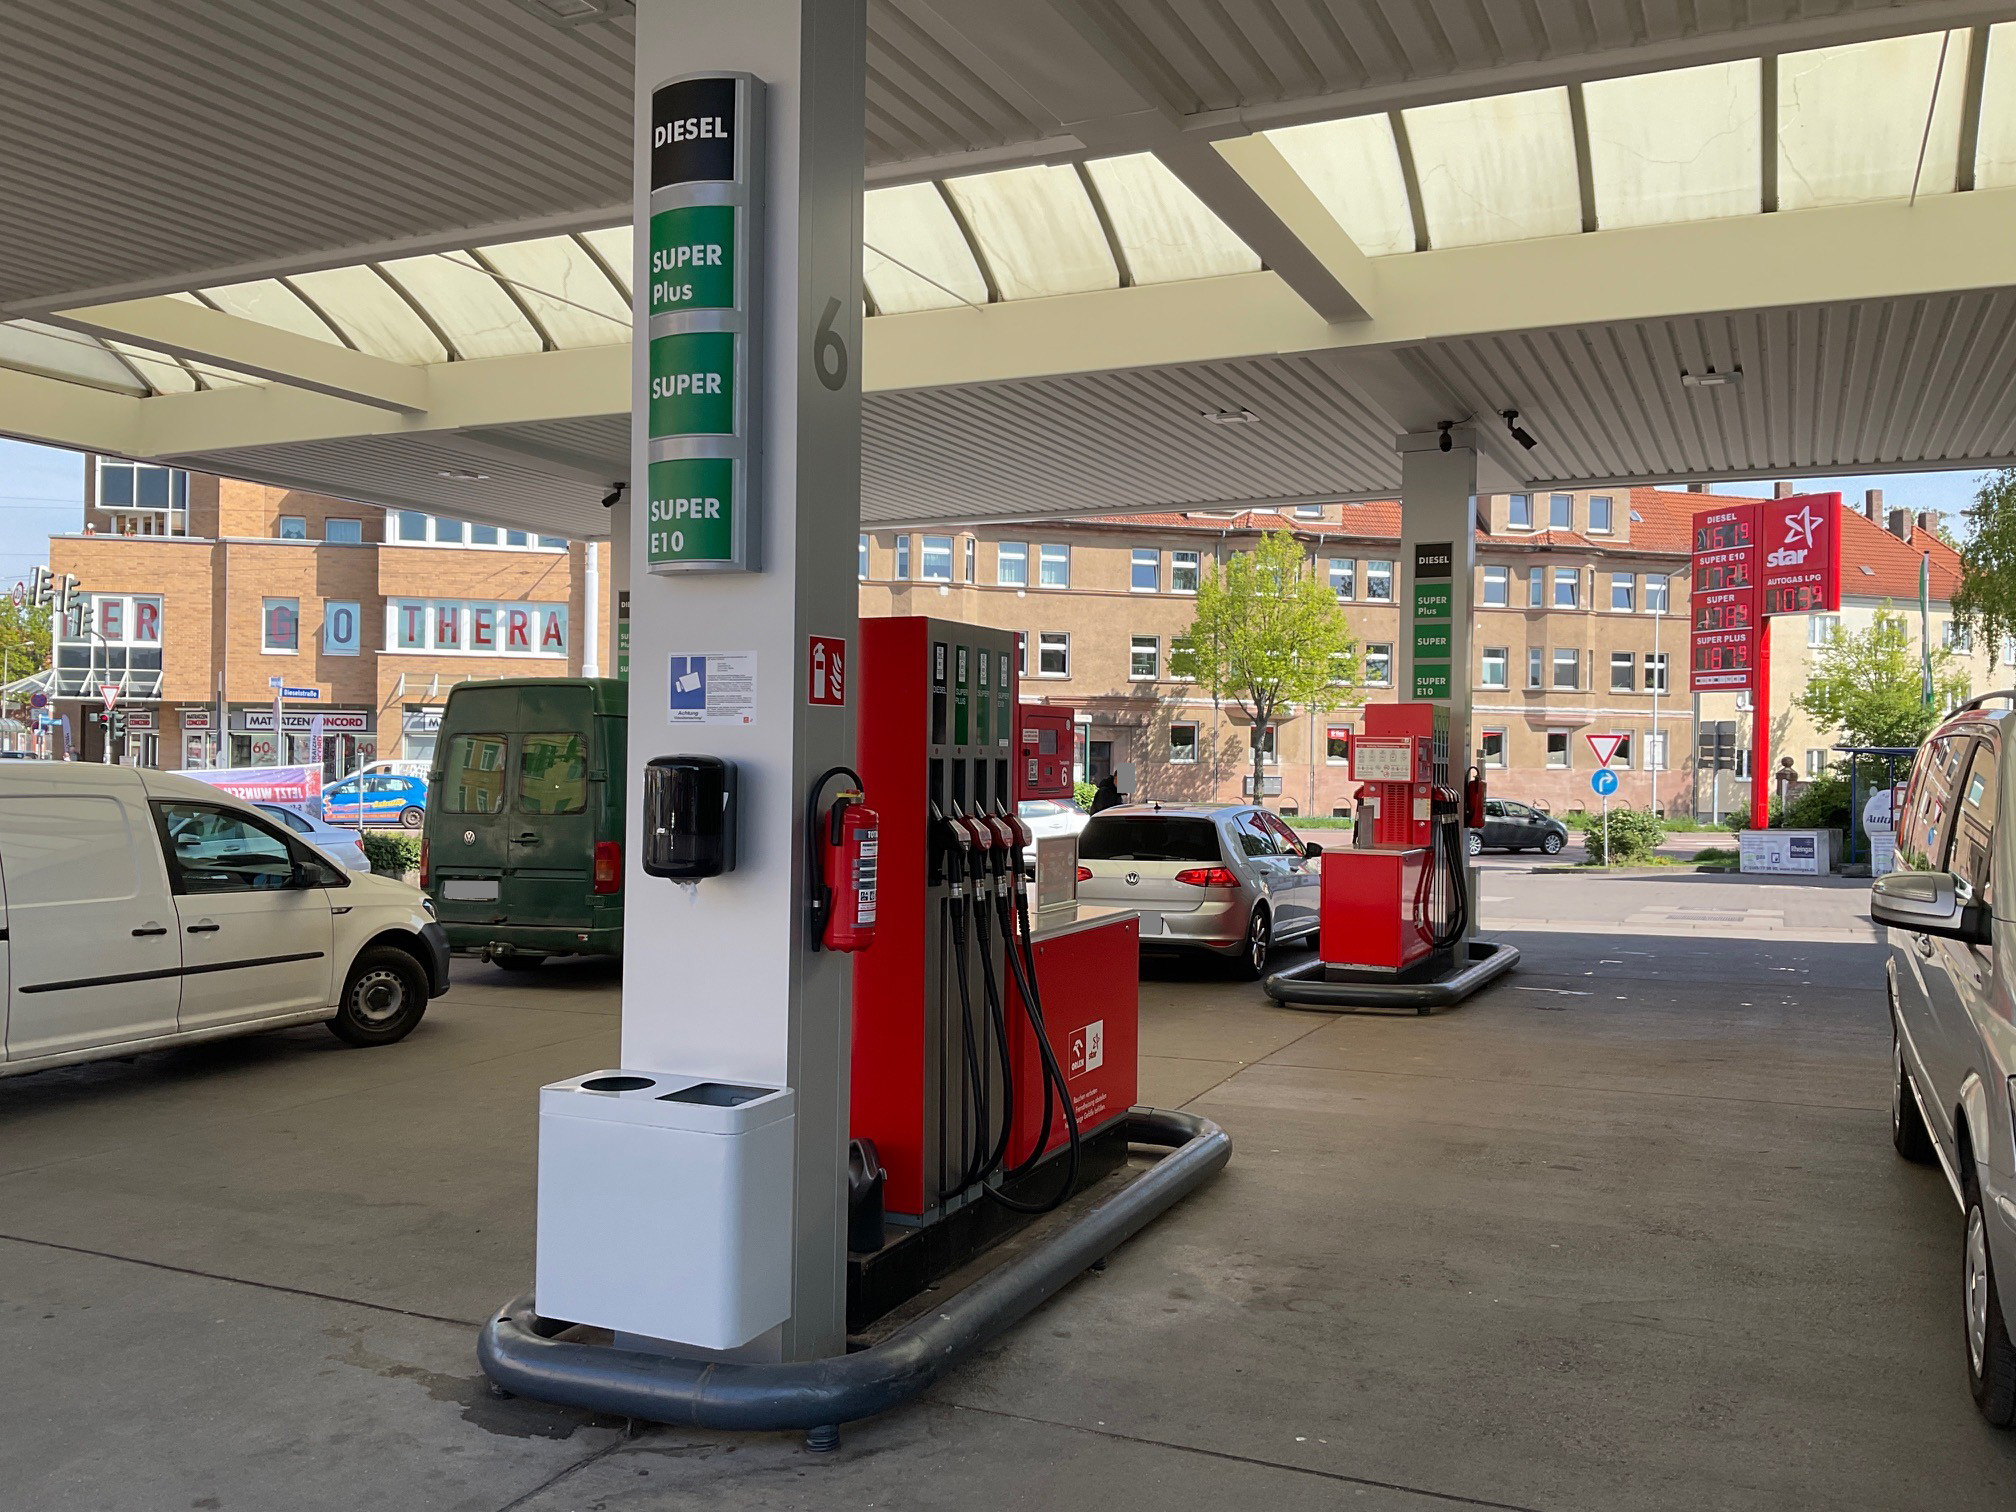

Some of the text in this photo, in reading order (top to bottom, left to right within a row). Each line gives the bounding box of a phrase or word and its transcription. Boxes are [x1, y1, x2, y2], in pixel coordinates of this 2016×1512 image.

[655, 117, 728, 149] DIESEL
[653, 244, 722, 273] SUPER
[654, 281, 692, 306] Plus
[814, 296, 848, 392] 6
[652, 373, 722, 400] SUPER
[651, 497, 720, 522] SUPER
[1707, 512, 1737, 525] DIESEL
[651, 531, 684, 554] E10
[1418, 556, 1450, 565] DIESEL
[1700, 552, 1745, 566] SUPER E10
[1766, 547, 1808, 568] star
[1767, 574, 1822, 586] AUTOGAS LPG
[1418, 596, 1447, 605] SUPER
[1706, 594, 1735, 604] SUPER
[1418, 607, 1437, 615] Plus
[1417, 638, 1446, 646] SUPER
[1696, 634, 1746, 645] SUPER PLUS
[1416, 677, 1446, 685] SUPER
[284, 689, 317, 698] Dieselstraße
[1416, 688, 1434, 696] E10
[250, 716, 310, 726] MATATZEN
[1062, 766, 1068, 786] 6
